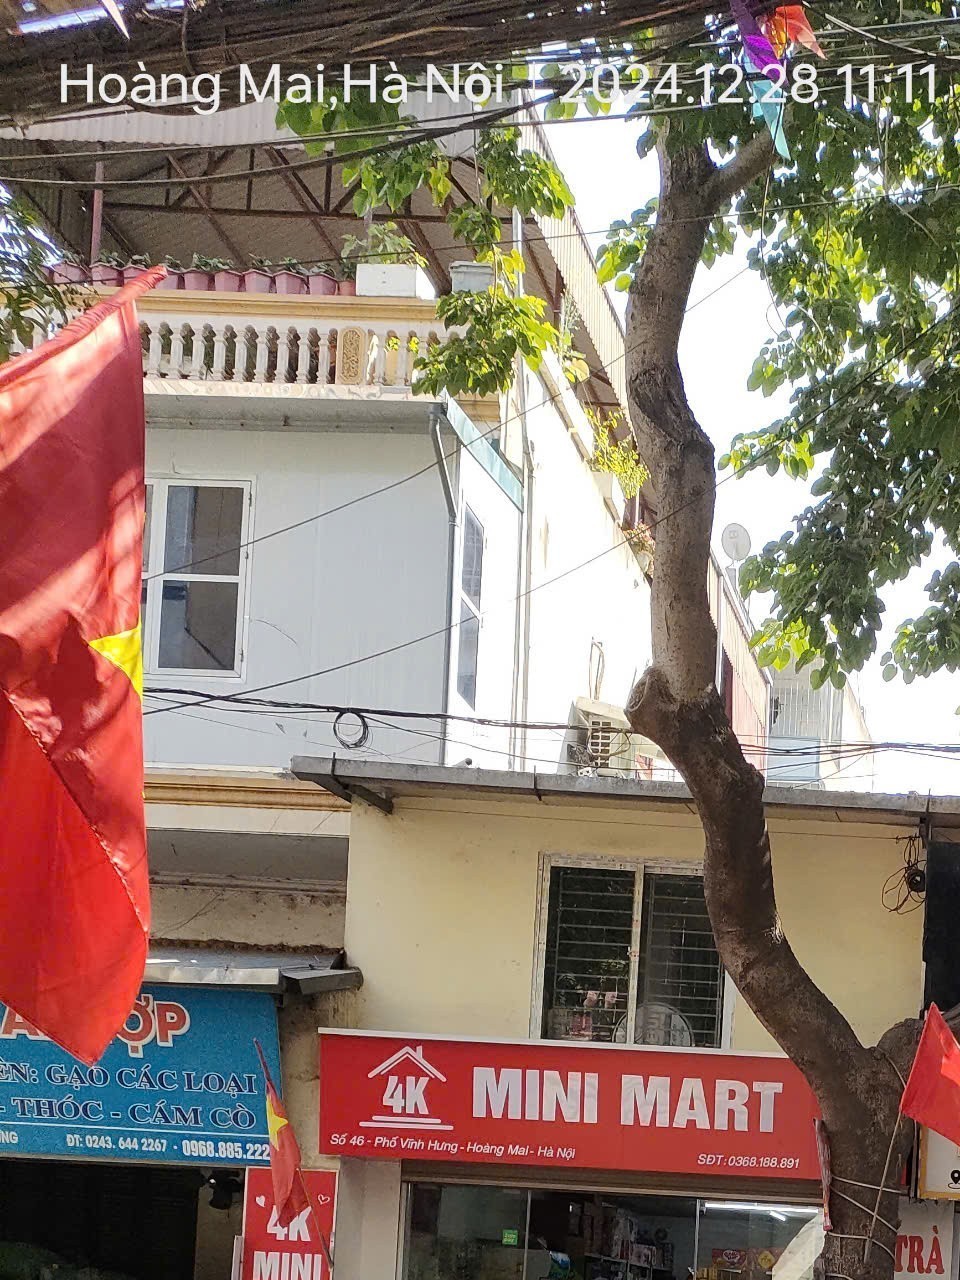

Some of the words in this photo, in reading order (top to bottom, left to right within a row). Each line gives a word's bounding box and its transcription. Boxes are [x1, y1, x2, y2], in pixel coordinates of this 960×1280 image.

[109, 994, 191, 1058] ỢP
[45, 1063, 110, 1090] GẠO
[116, 1064, 178, 1091] CÁC
[184, 1071, 257, 1098] LOẠI
[12, 1094, 103, 1121] THÓC
[129, 1099, 202, 1127] CÁM
[209, 1103, 256, 1129] CÒ
[382, 1074, 429, 1115] 4K
[472, 1067, 598, 1124] MINI
[621, 1074, 784, 1133] MART
[66, 1133, 84, 1147] ĐT:
[85, 1136, 115, 1149] 0243.
[119, 1138, 138, 1150] 644
[142, 1139, 167, 1152] 2267
[182, 1139, 270, 1160] 0968.885.222
[330, 1132, 348, 1145] Số
[349, 1134, 365, 1147] 46
[374, 1135, 399, 1148] Phố
[400, 1136, 425, 1150] Vĩnh
[427, 1139, 458, 1154] Hưng
[466, 1142, 504, 1157] Hoàng
[537, 1146, 554, 1158] Hà
[557, 1147, 576, 1160] Nội
[266, 1205, 312, 1242] 4K
[894, 1225, 945, 1275] TRÀ
